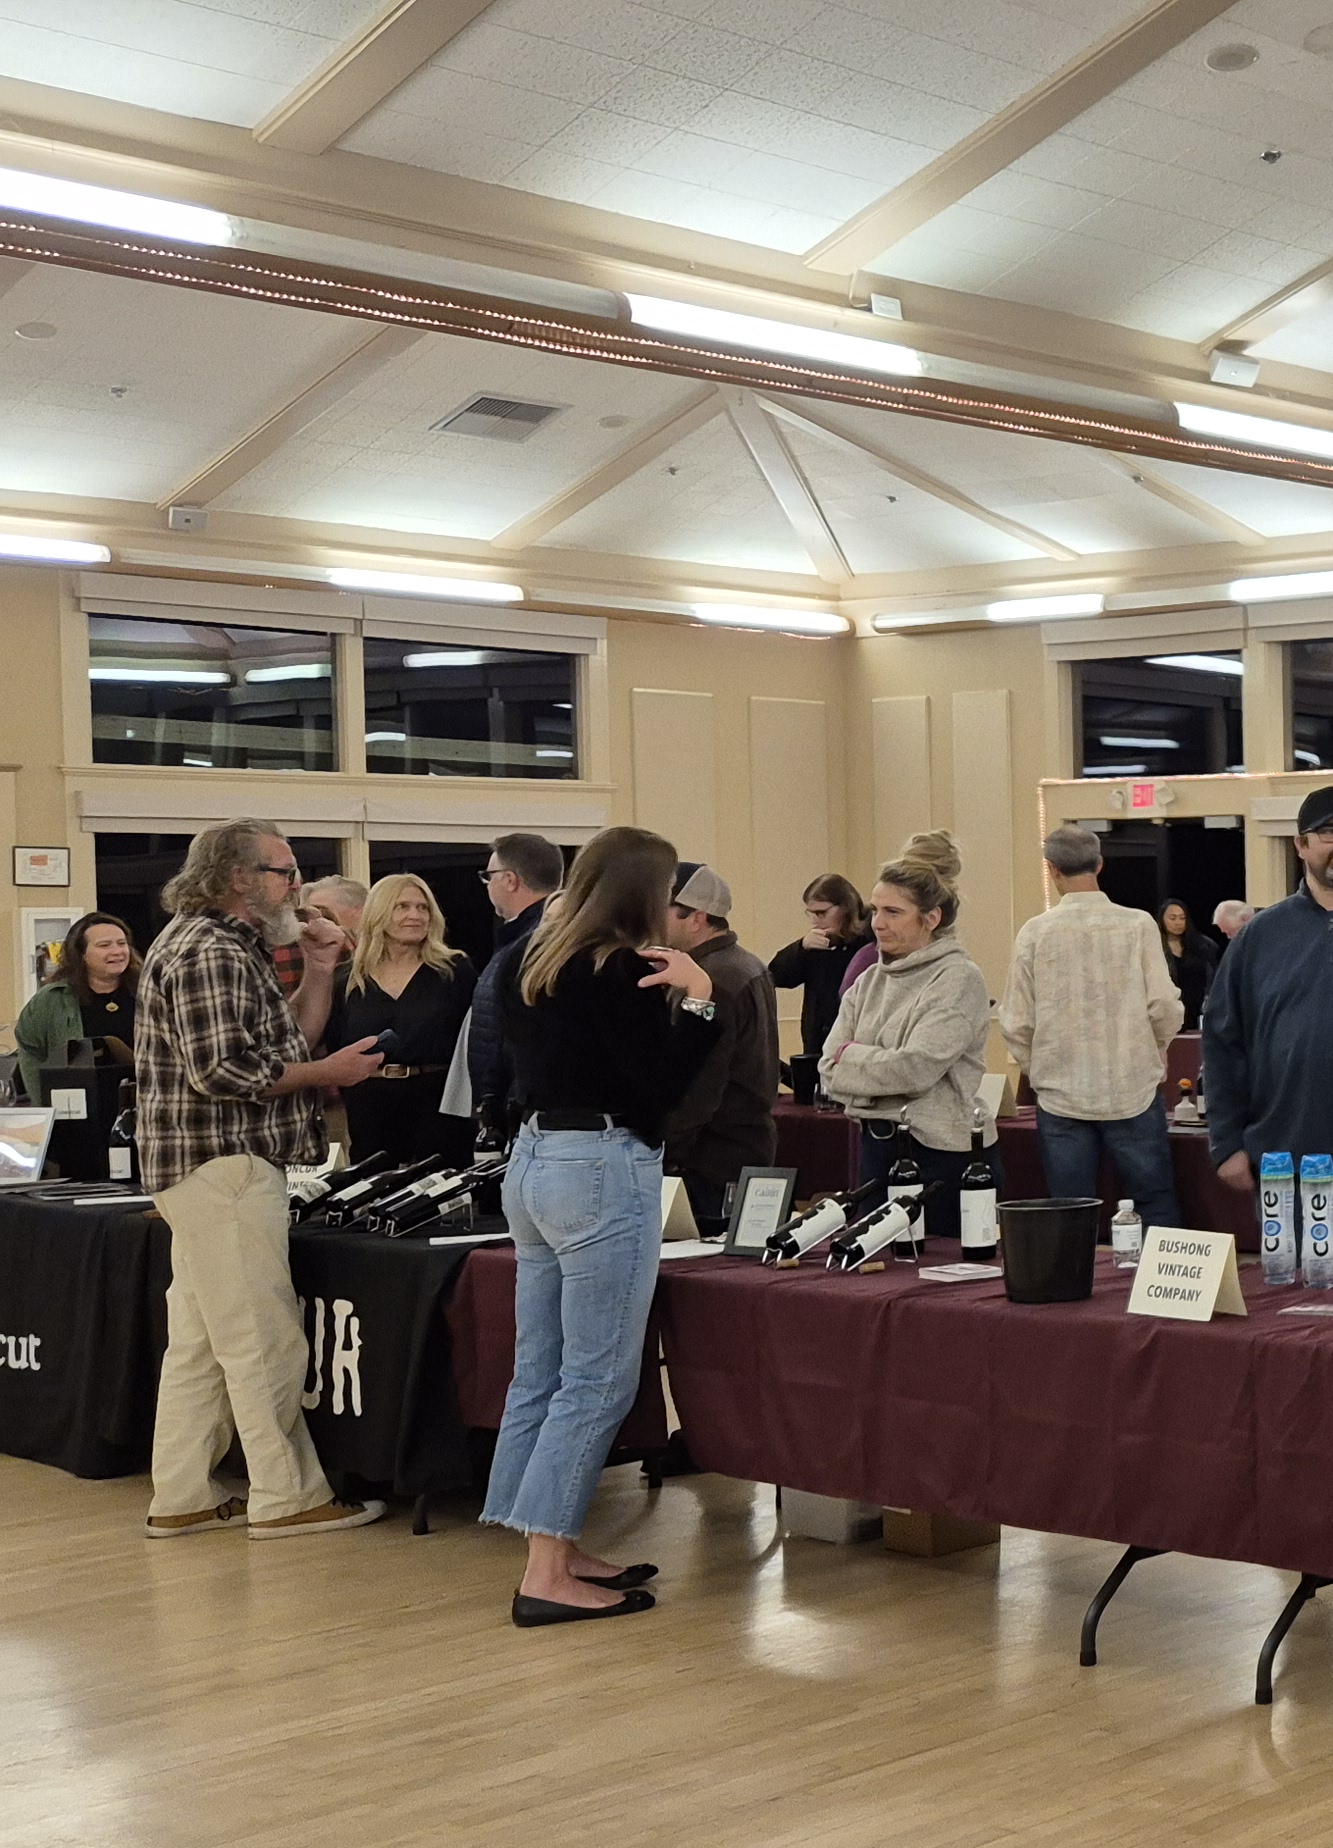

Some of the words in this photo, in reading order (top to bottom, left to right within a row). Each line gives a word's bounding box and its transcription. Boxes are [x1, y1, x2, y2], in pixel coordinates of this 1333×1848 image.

[1263, 1190, 1281, 1252] core
[1310, 1193, 1329, 1257] core
[1158, 1240, 1212, 1257] BUSHONG
[1157, 1262, 1203, 1279] VINTAGE
[1147, 1285, 1202, 1302] COMPANY
